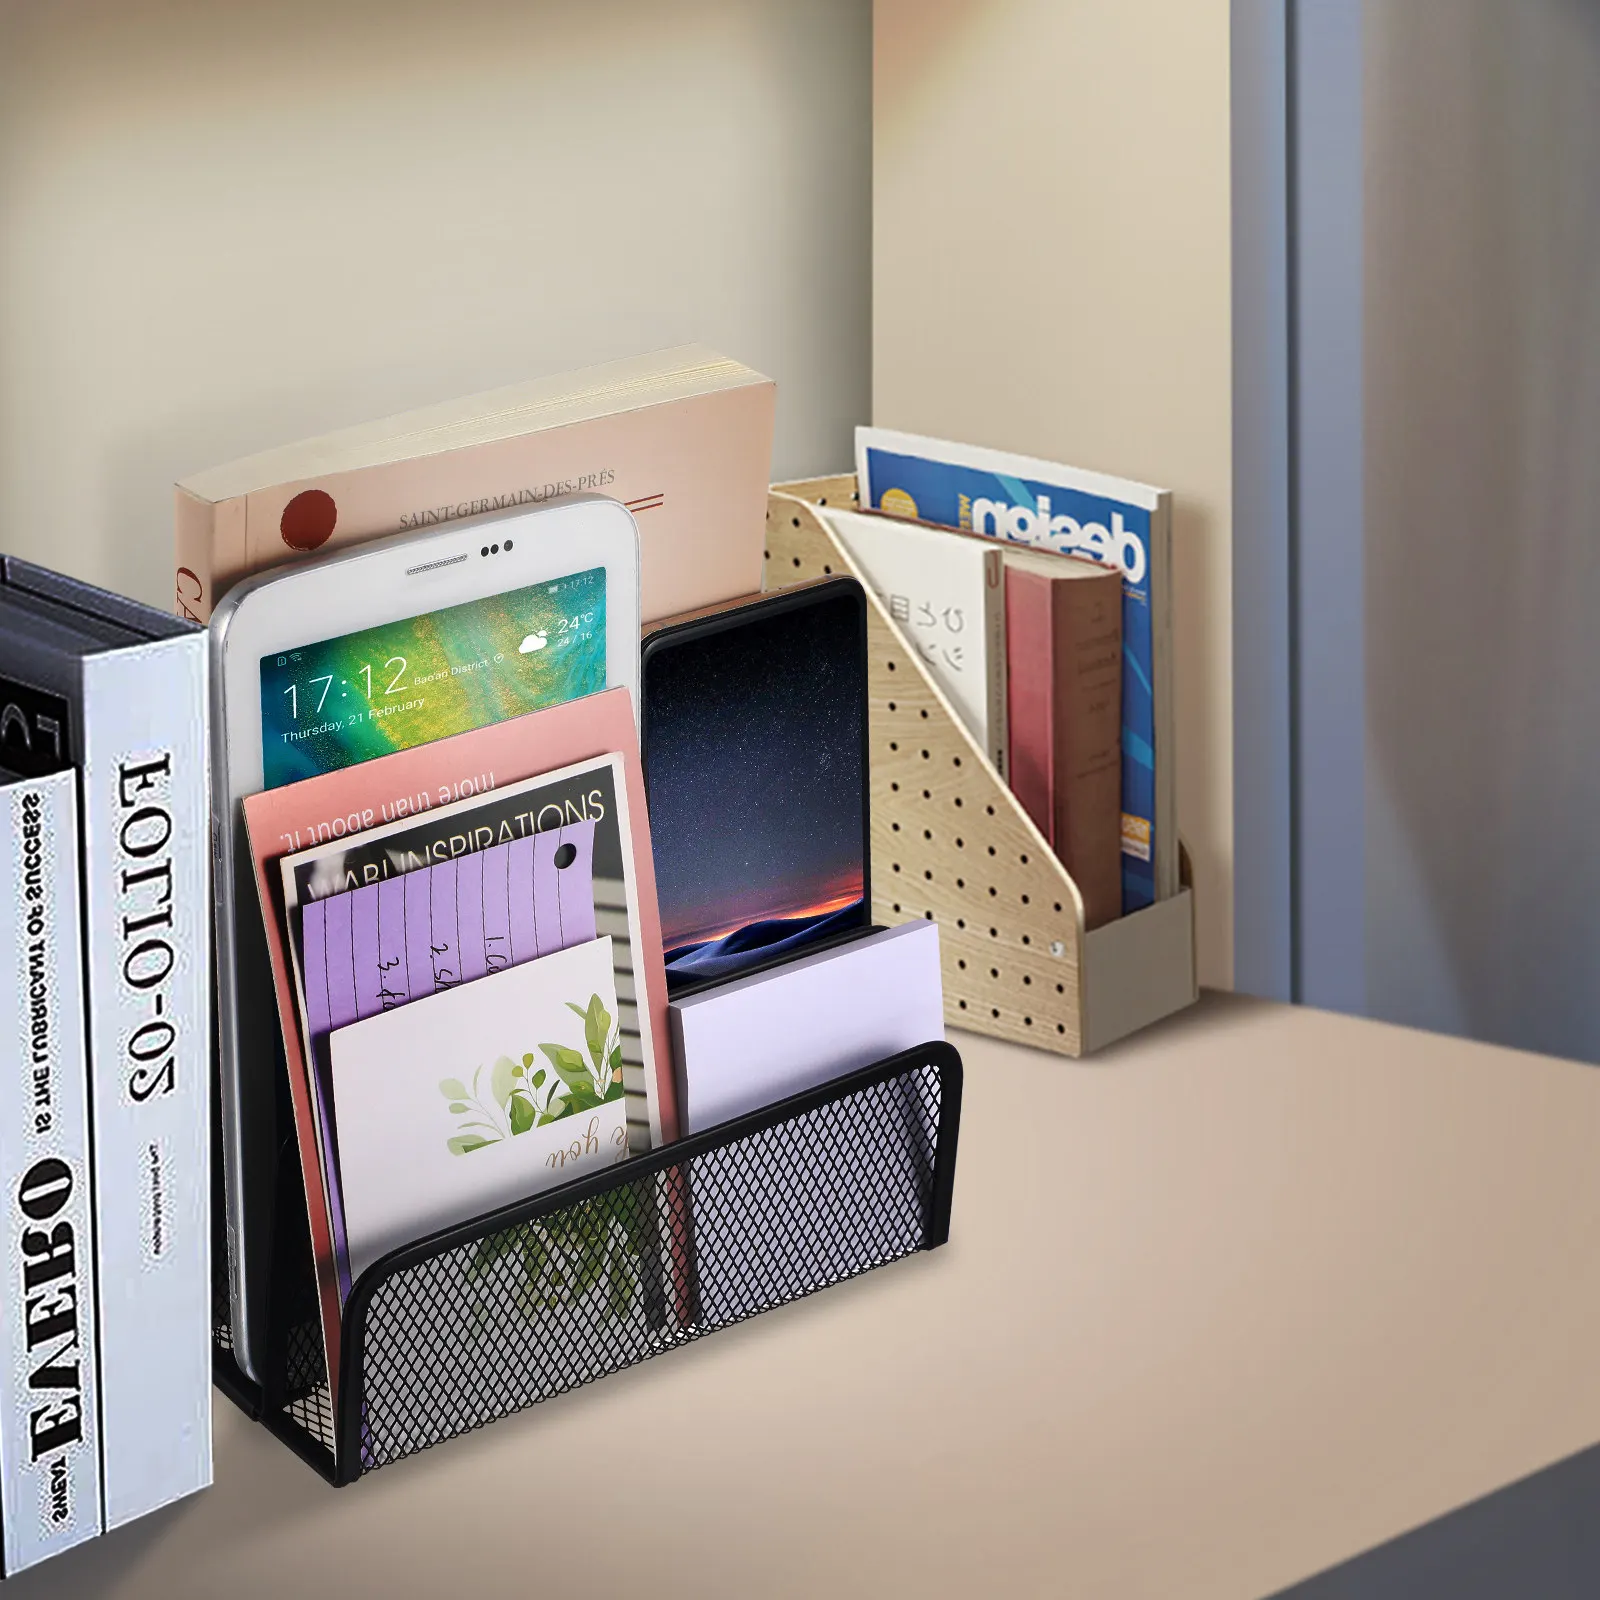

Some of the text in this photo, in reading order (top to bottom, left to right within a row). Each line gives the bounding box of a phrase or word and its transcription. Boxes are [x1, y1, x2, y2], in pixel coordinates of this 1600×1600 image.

[284, 656, 408, 719] 17:12
[451, 659, 489, 676] District
[281, 698, 425, 743] Thursday, 21 February
[438, 771, 495, 804] more
[545, 1116, 599, 1169] you
